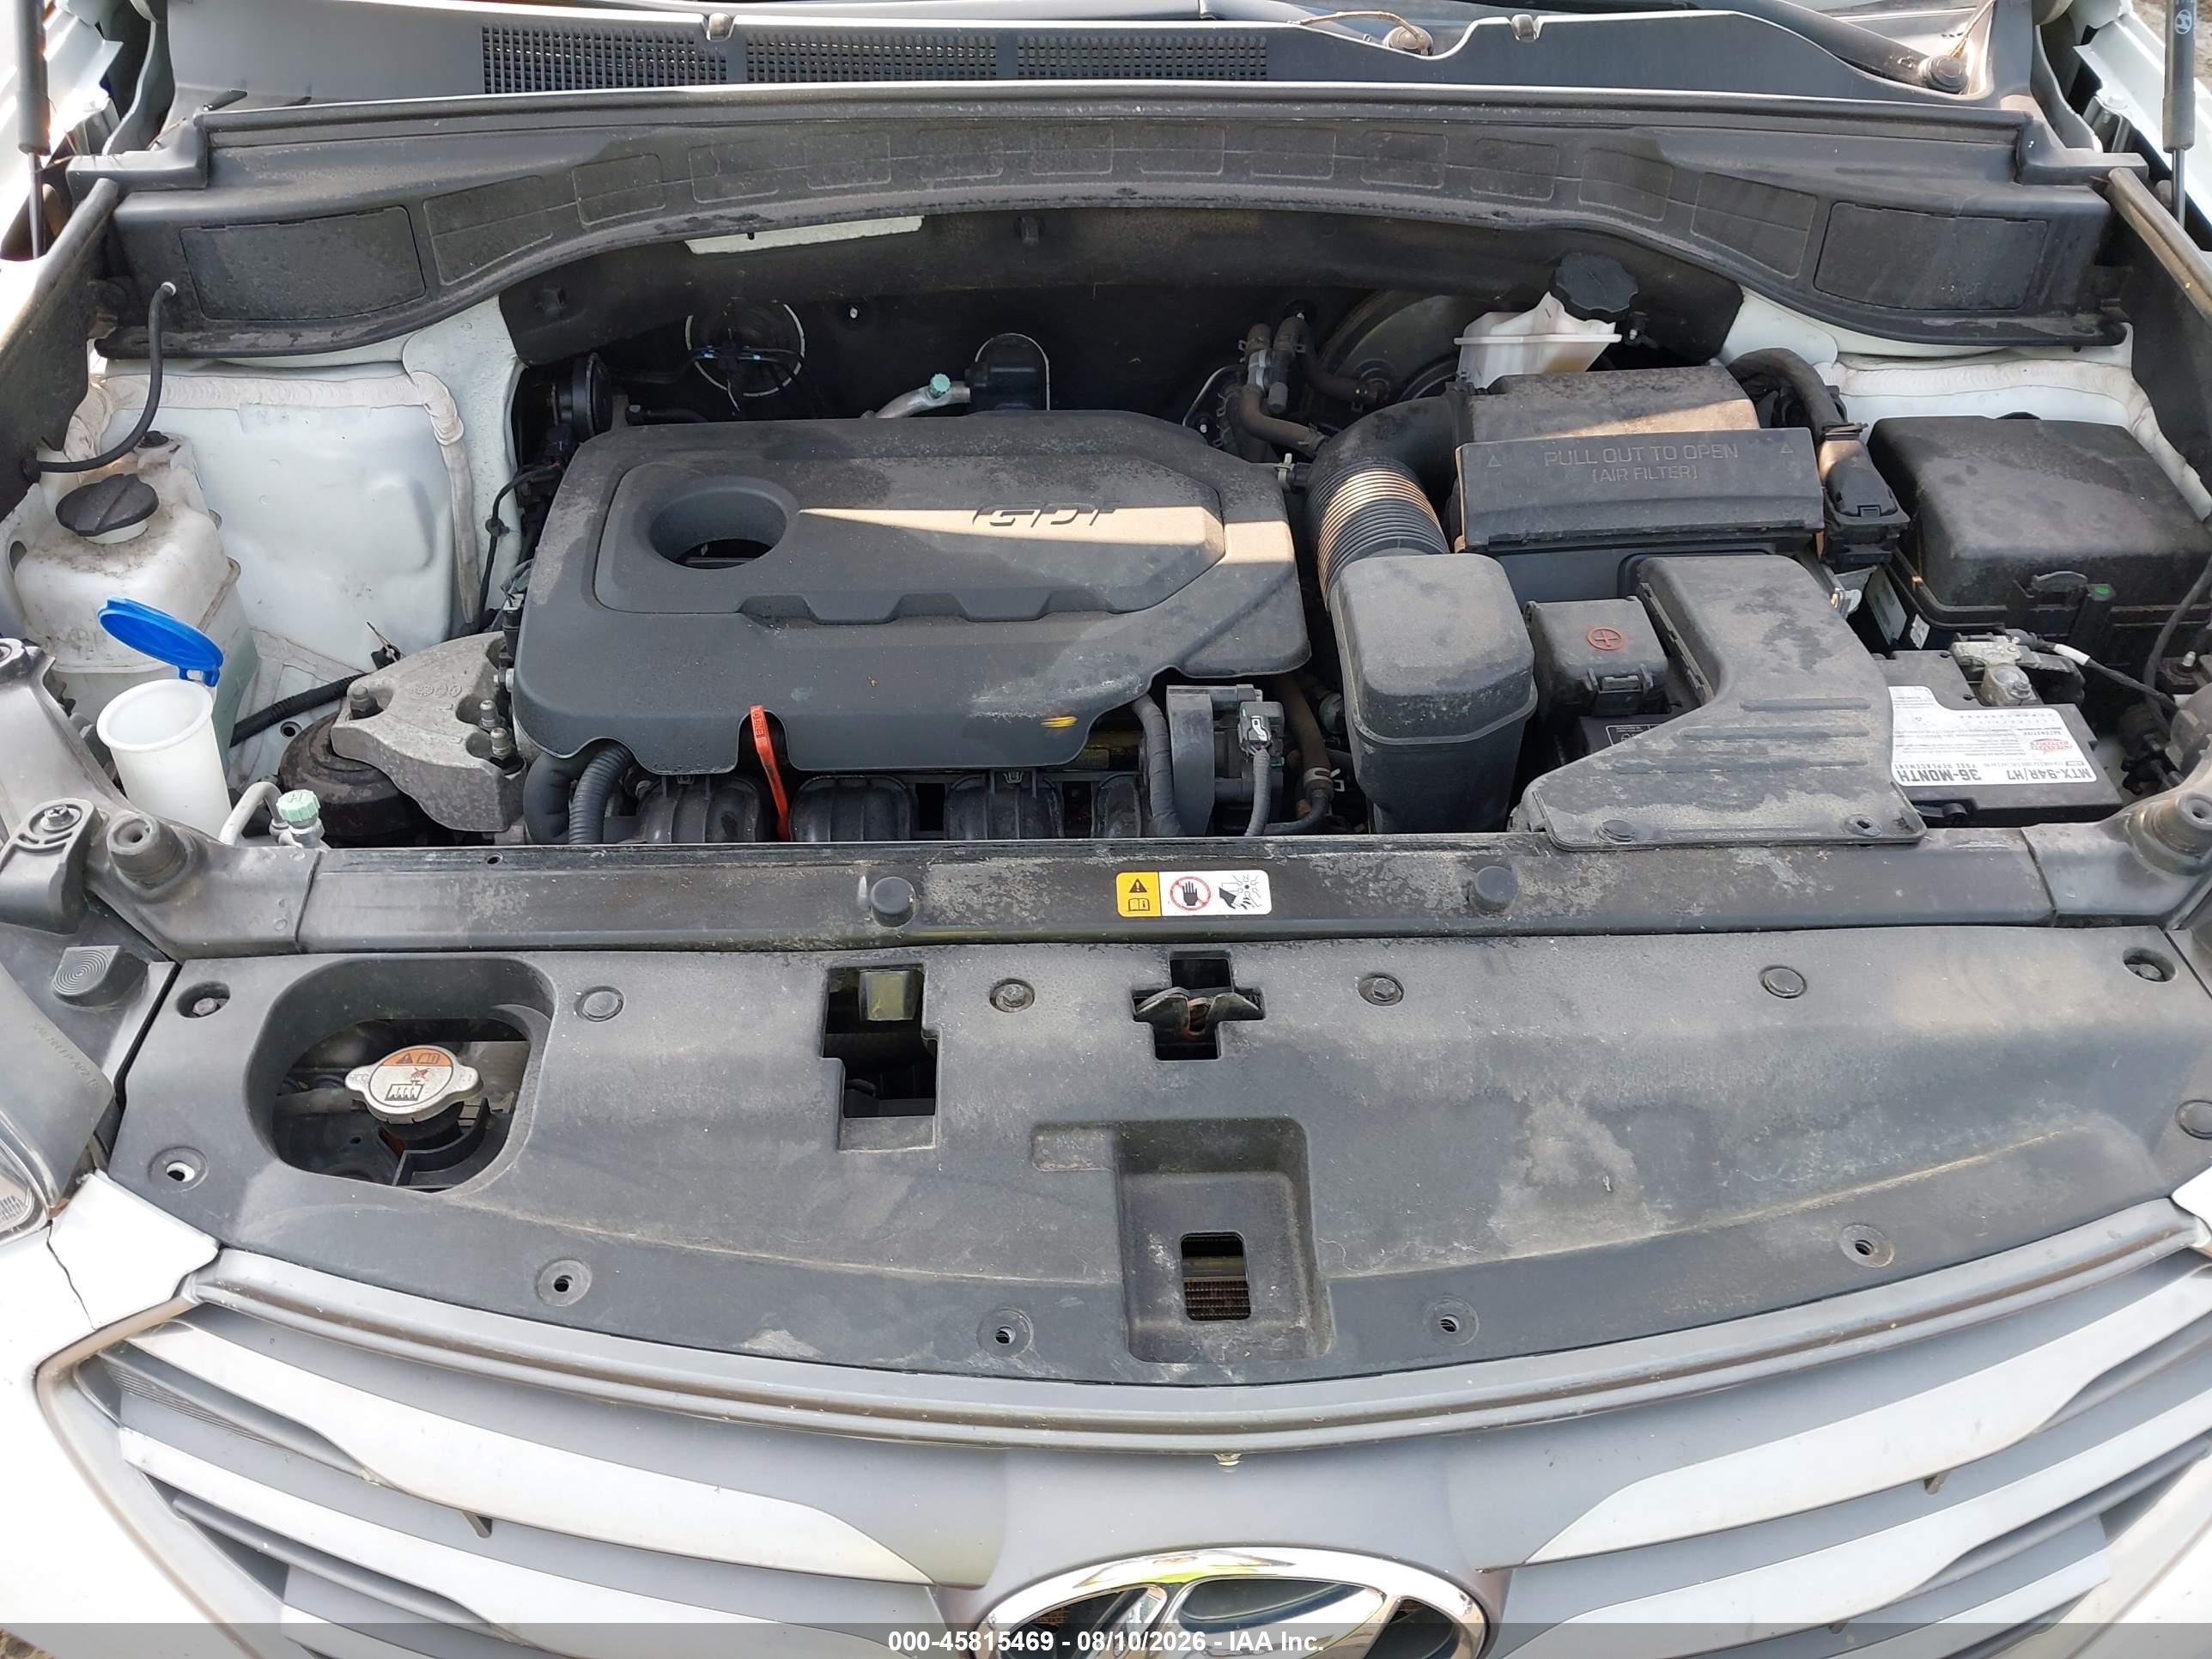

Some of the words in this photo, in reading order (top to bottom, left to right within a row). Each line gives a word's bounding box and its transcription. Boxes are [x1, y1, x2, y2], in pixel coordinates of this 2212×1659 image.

[1544, 448, 1597, 466] PULL
[1602, 447, 1644, 464] OUT
[1648, 446, 1677, 461] TO
[1682, 443, 1738, 460] OPEN
[972, 501, 1120, 528] GDI
[1896, 769, 1982, 782] 36-MONTH
[2006, 768, 2093, 781] MTX-94R/H7
